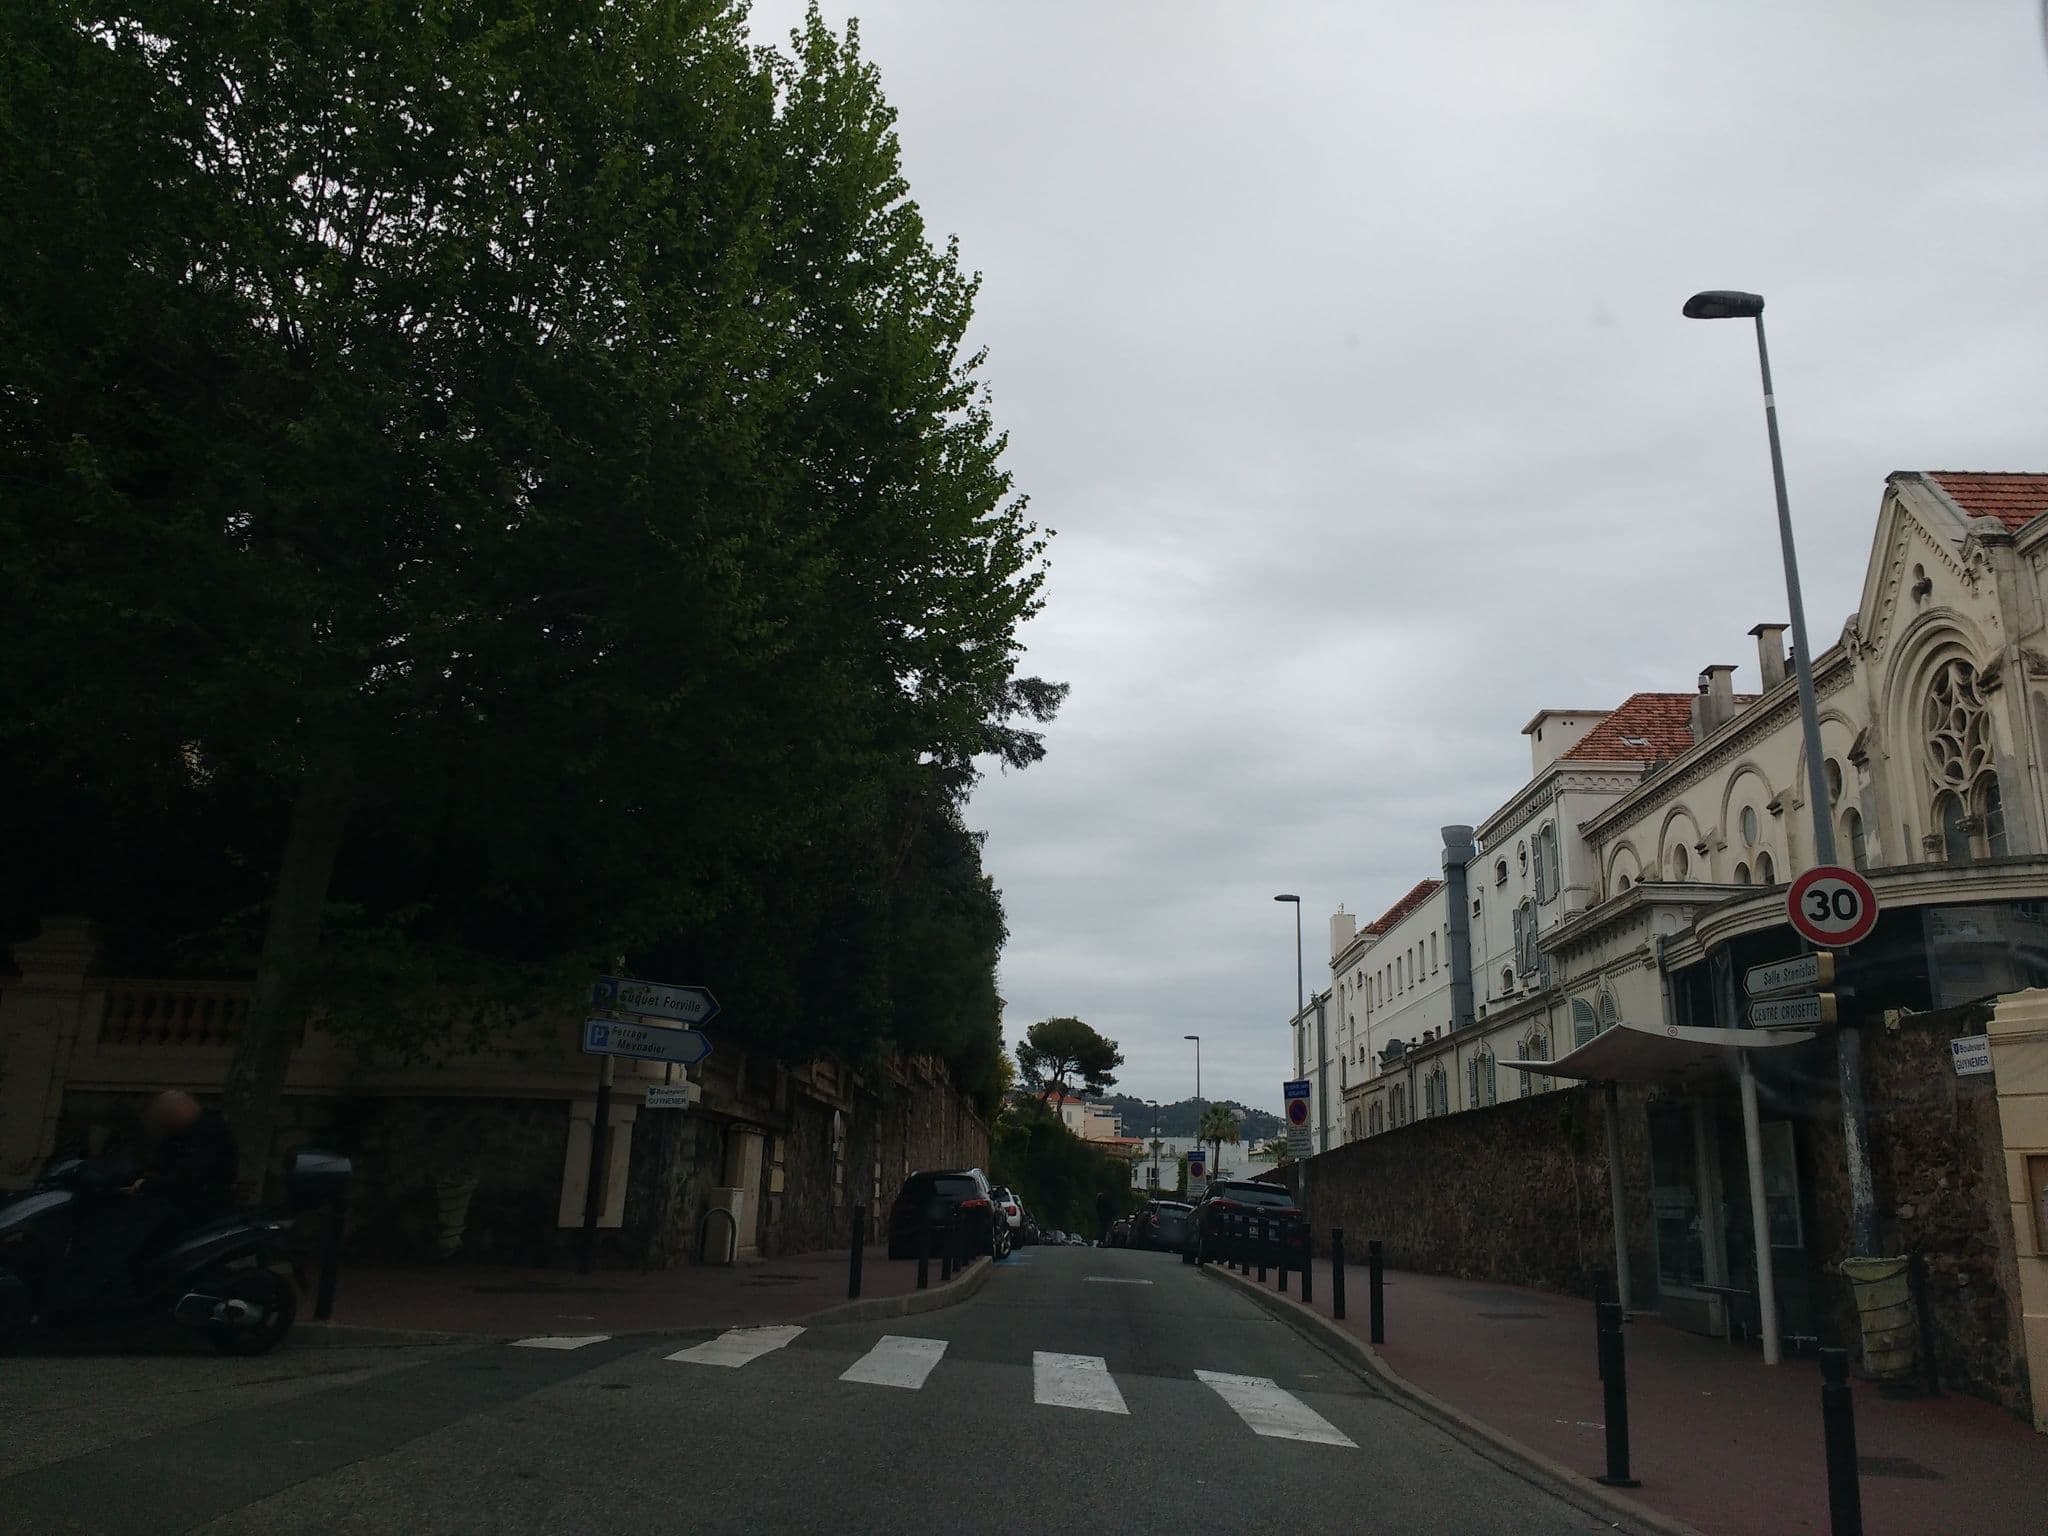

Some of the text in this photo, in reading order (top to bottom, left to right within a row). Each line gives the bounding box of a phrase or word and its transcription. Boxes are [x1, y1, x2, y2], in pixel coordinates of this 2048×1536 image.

[1806, 888, 1858, 921] 30
[1764, 964, 1817, 986] Salle Stanislas
[663, 996, 701, 1012] Forville
[1755, 1003, 1819, 1021] CENTRE CROISETTE
[1957, 1056, 1989, 1069] GUYNEMER
